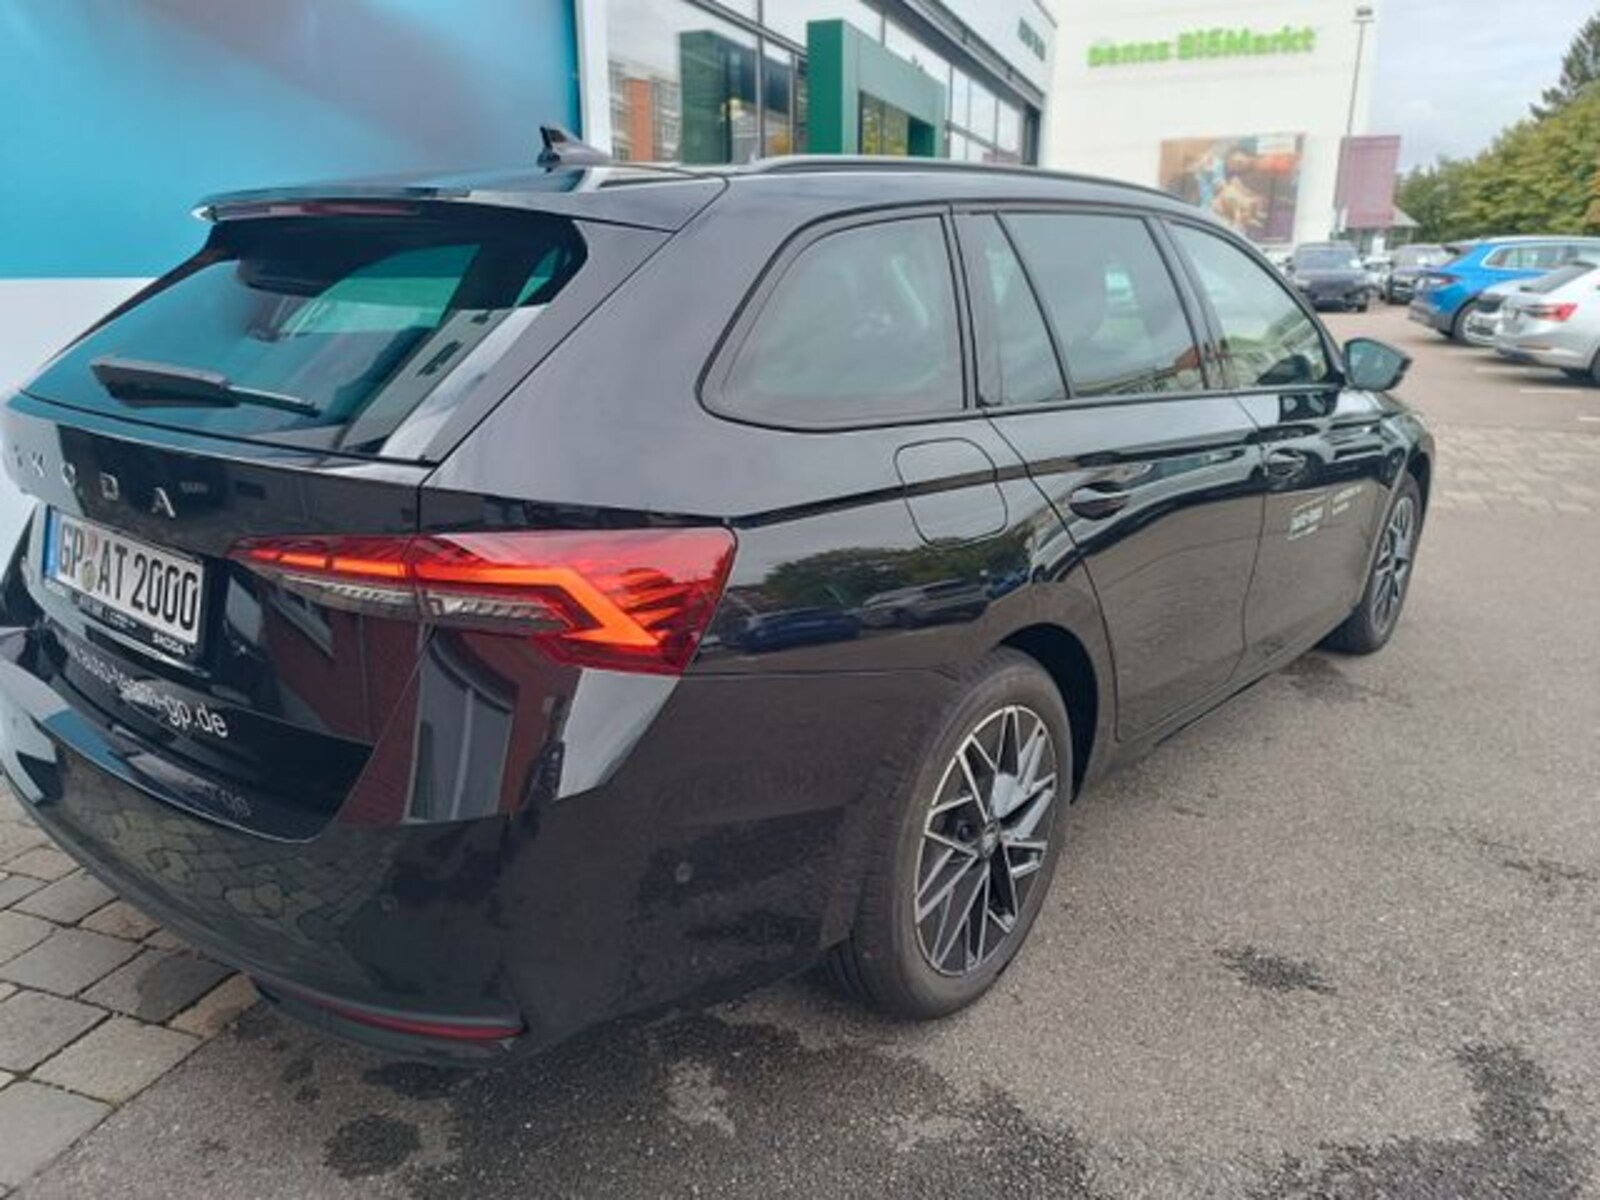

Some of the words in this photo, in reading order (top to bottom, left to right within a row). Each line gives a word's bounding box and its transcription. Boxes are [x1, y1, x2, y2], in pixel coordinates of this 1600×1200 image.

[60, 522, 85, 578] GP
[97, 540, 128, 600] AT
[131, 552, 198, 631] 2000
